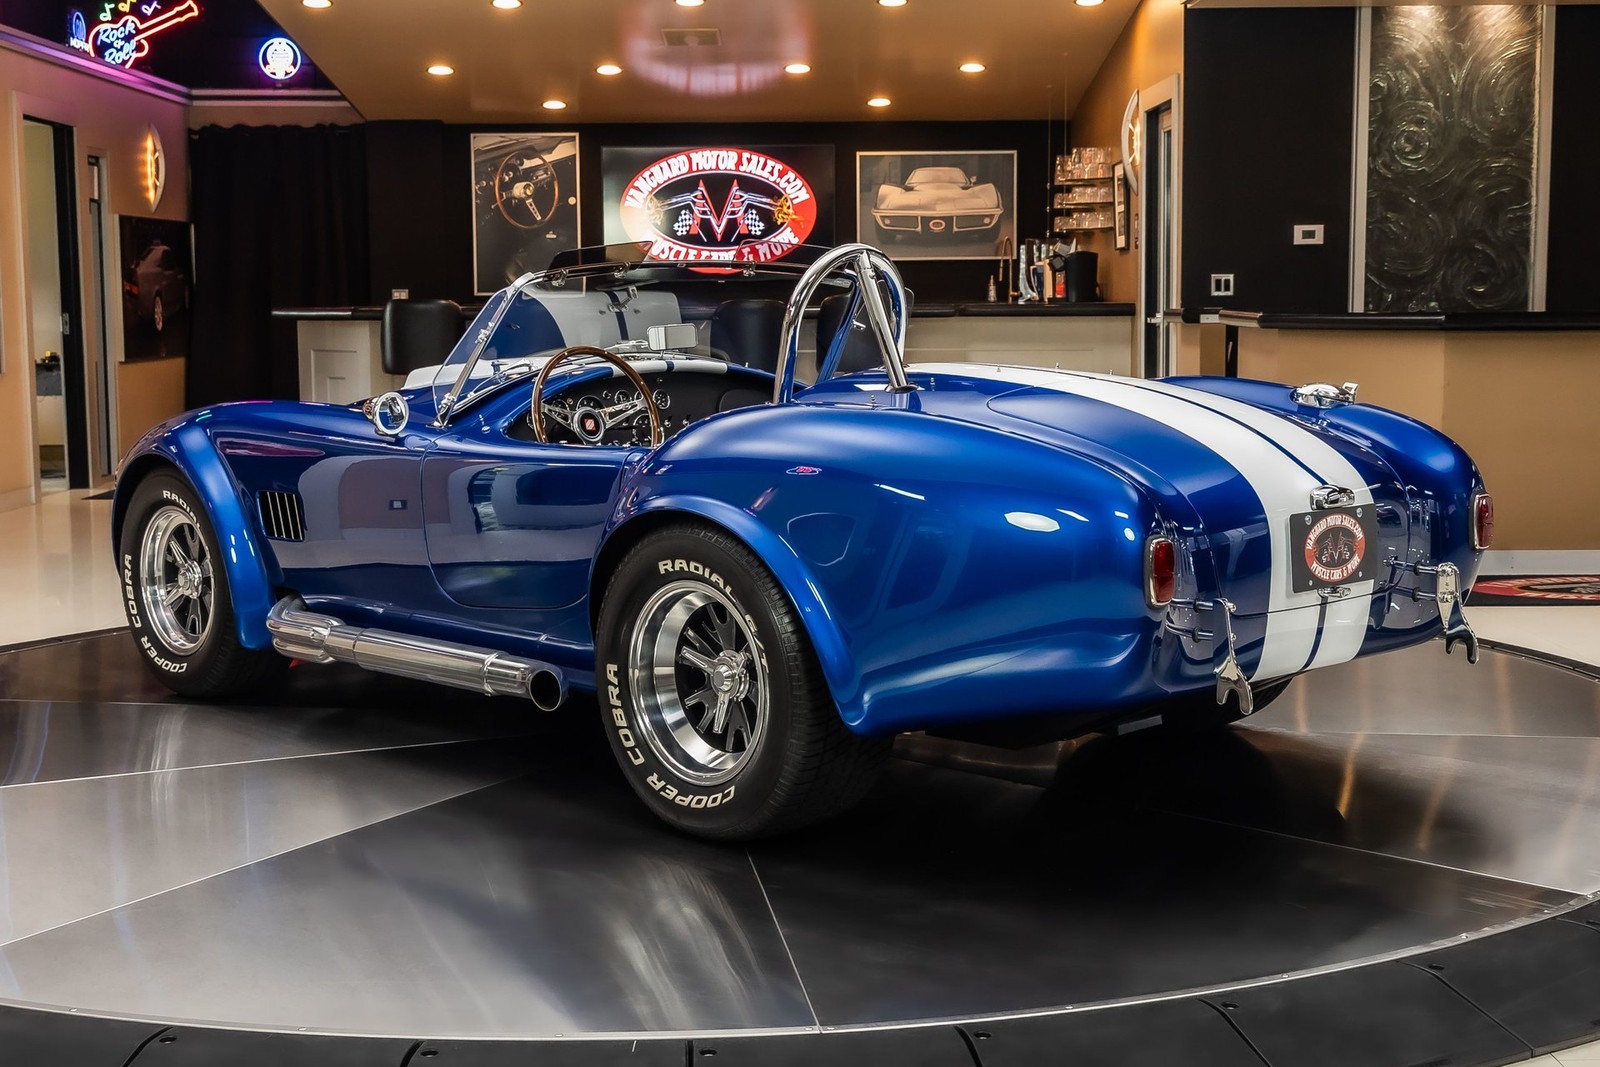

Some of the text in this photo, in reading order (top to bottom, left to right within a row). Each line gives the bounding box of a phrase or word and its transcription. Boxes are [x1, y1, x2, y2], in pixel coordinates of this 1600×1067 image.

[97, 18, 136, 46] Rock
[104, 39, 137, 64] Roll
[624, 150, 811, 209] VANGUARD MOTOR SALES.COM
[658, 559, 737, 603] RADIAL
[1311, 561, 1331, 580] MUSCLE
[124, 553, 142, 628] COBRA
[140, 635, 188, 673] COOPER
[605, 663, 645, 766] COBRA
[646, 772, 736, 809] COOPER
